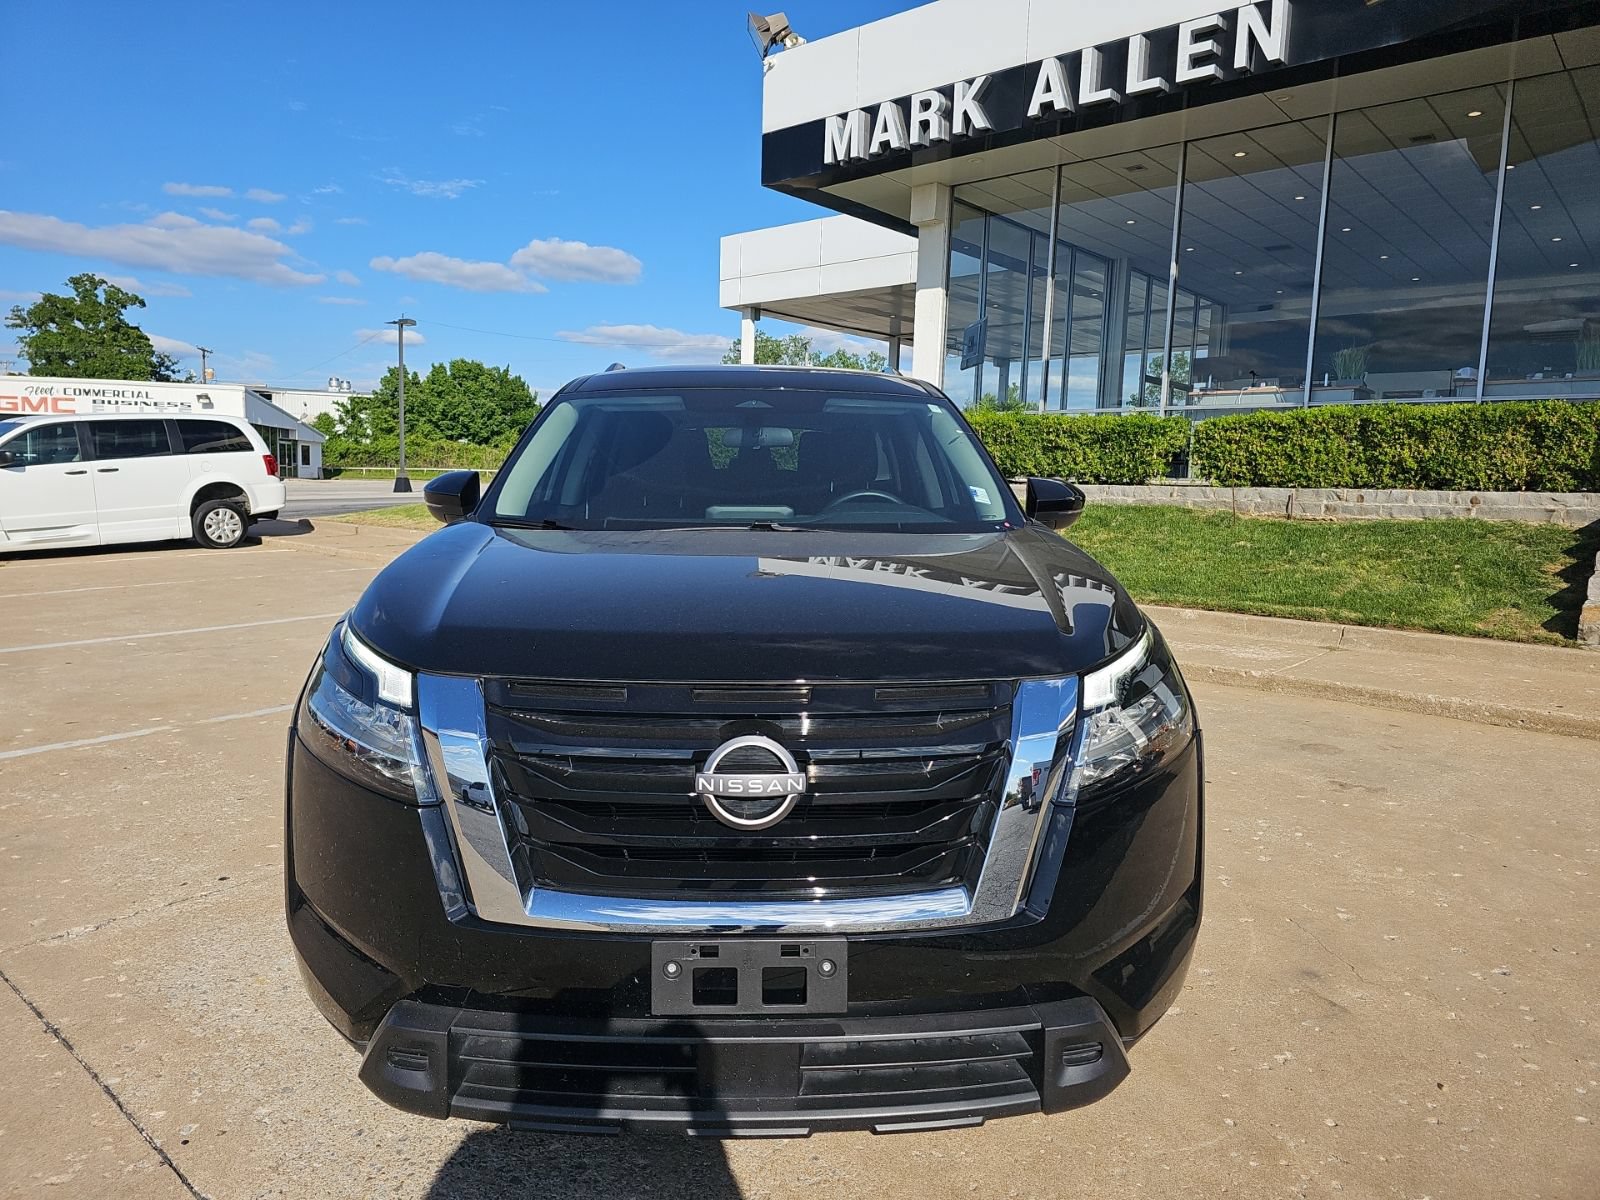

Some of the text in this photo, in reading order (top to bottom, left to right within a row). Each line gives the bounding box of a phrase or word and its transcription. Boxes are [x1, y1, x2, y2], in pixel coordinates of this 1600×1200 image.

[824, 0, 1293, 166] MARK ALLEN
[24, 385, 154, 400] Fleet COMMERCIAL
[0, 395, 76, 414] GMC
[91, 399, 192, 408] BUSINESS
[698, 777, 803, 793] NISSAN
